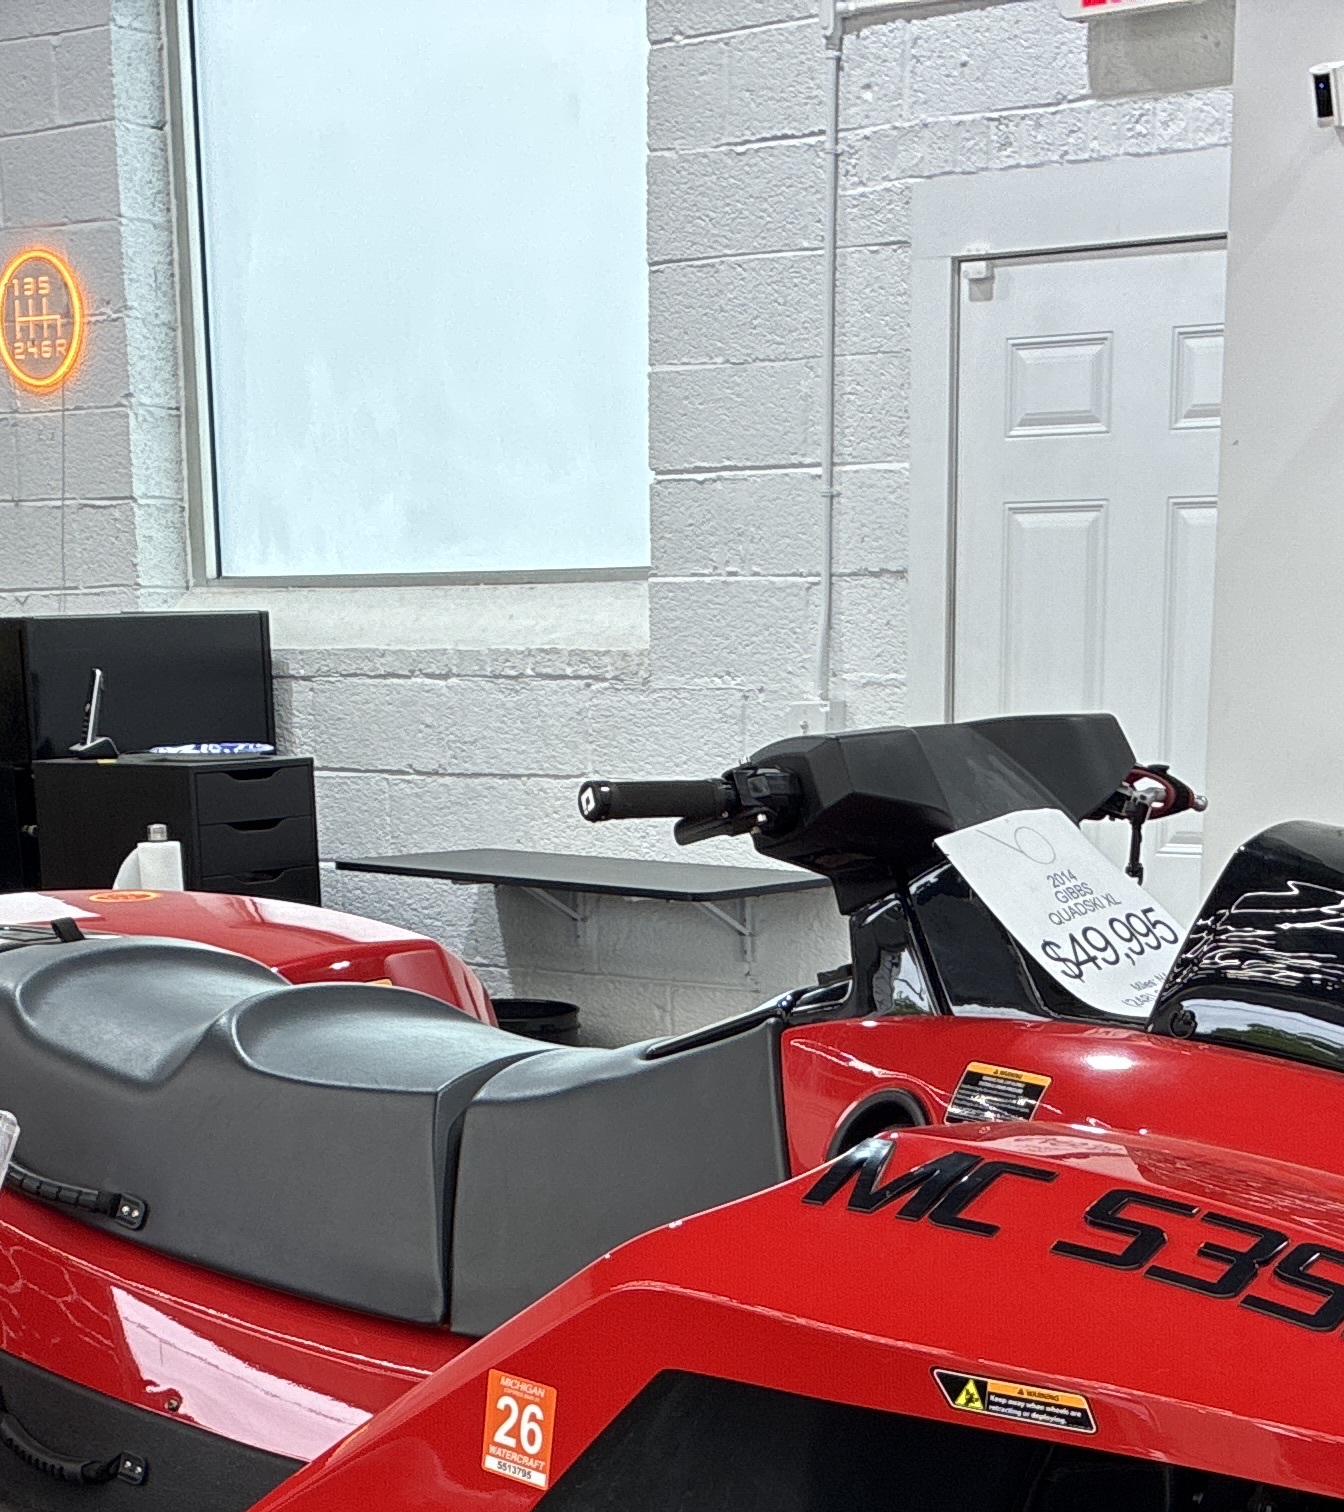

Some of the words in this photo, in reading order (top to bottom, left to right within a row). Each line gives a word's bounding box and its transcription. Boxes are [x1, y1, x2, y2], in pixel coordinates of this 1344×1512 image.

[1047, 869, 1078, 889] 2014
[1054, 882, 1094, 904] GIBBS
[1048, 898, 1106, 926] QUADSKI
[1103, 892, 1122, 907] XL
[1041, 907, 1179, 983] $49,995
[800, 1138, 1058, 1237] MC
[500, 1376, 545, 1398] MICHIGAN
[988, 1404, 1022, 1417] retracting
[989, 1394, 1008, 1404] Keep
[1008, 1399, 1025, 1409] away
[1026, 1401, 1045, 1411] when
[1045, 1405, 1069, 1416] wheels
[1070, 1409, 1082, 1418] are
[493, 1395, 544, 1455] 26
[488, 1444, 546, 1471] WATERCRAFT
[497, 1460, 532, 1480] 5513795
